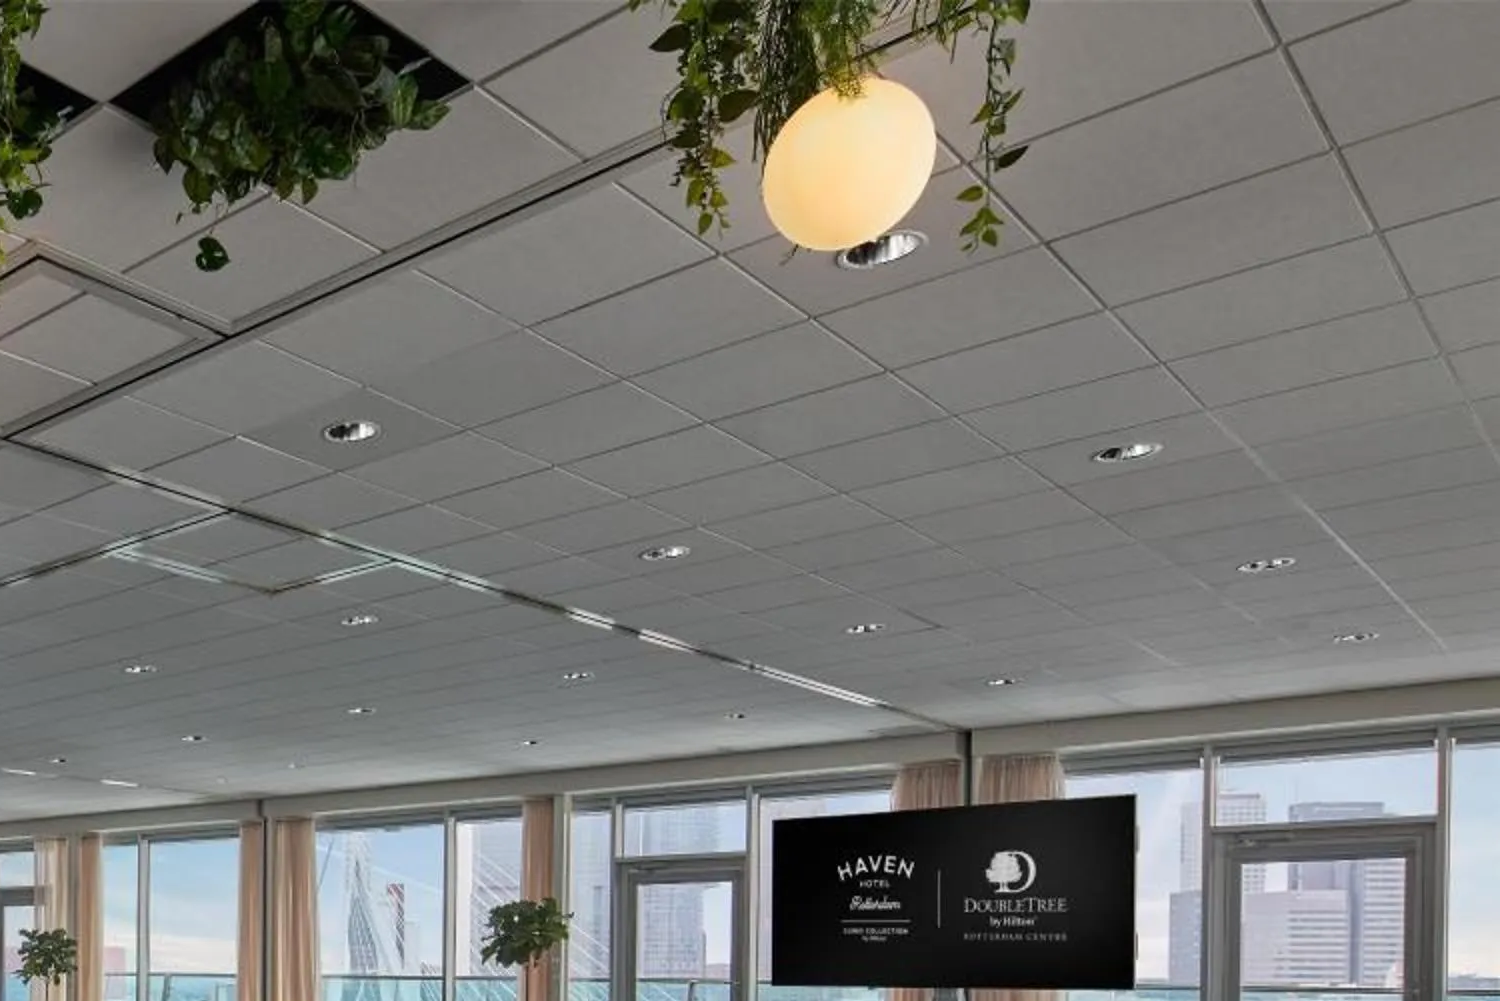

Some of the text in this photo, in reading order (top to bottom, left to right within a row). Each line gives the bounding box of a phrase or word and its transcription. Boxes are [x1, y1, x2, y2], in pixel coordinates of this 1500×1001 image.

[837, 855, 915, 881] HAVEN
[859, 879, 890, 888] HOTEL
[989, 915, 1001, 928] by
